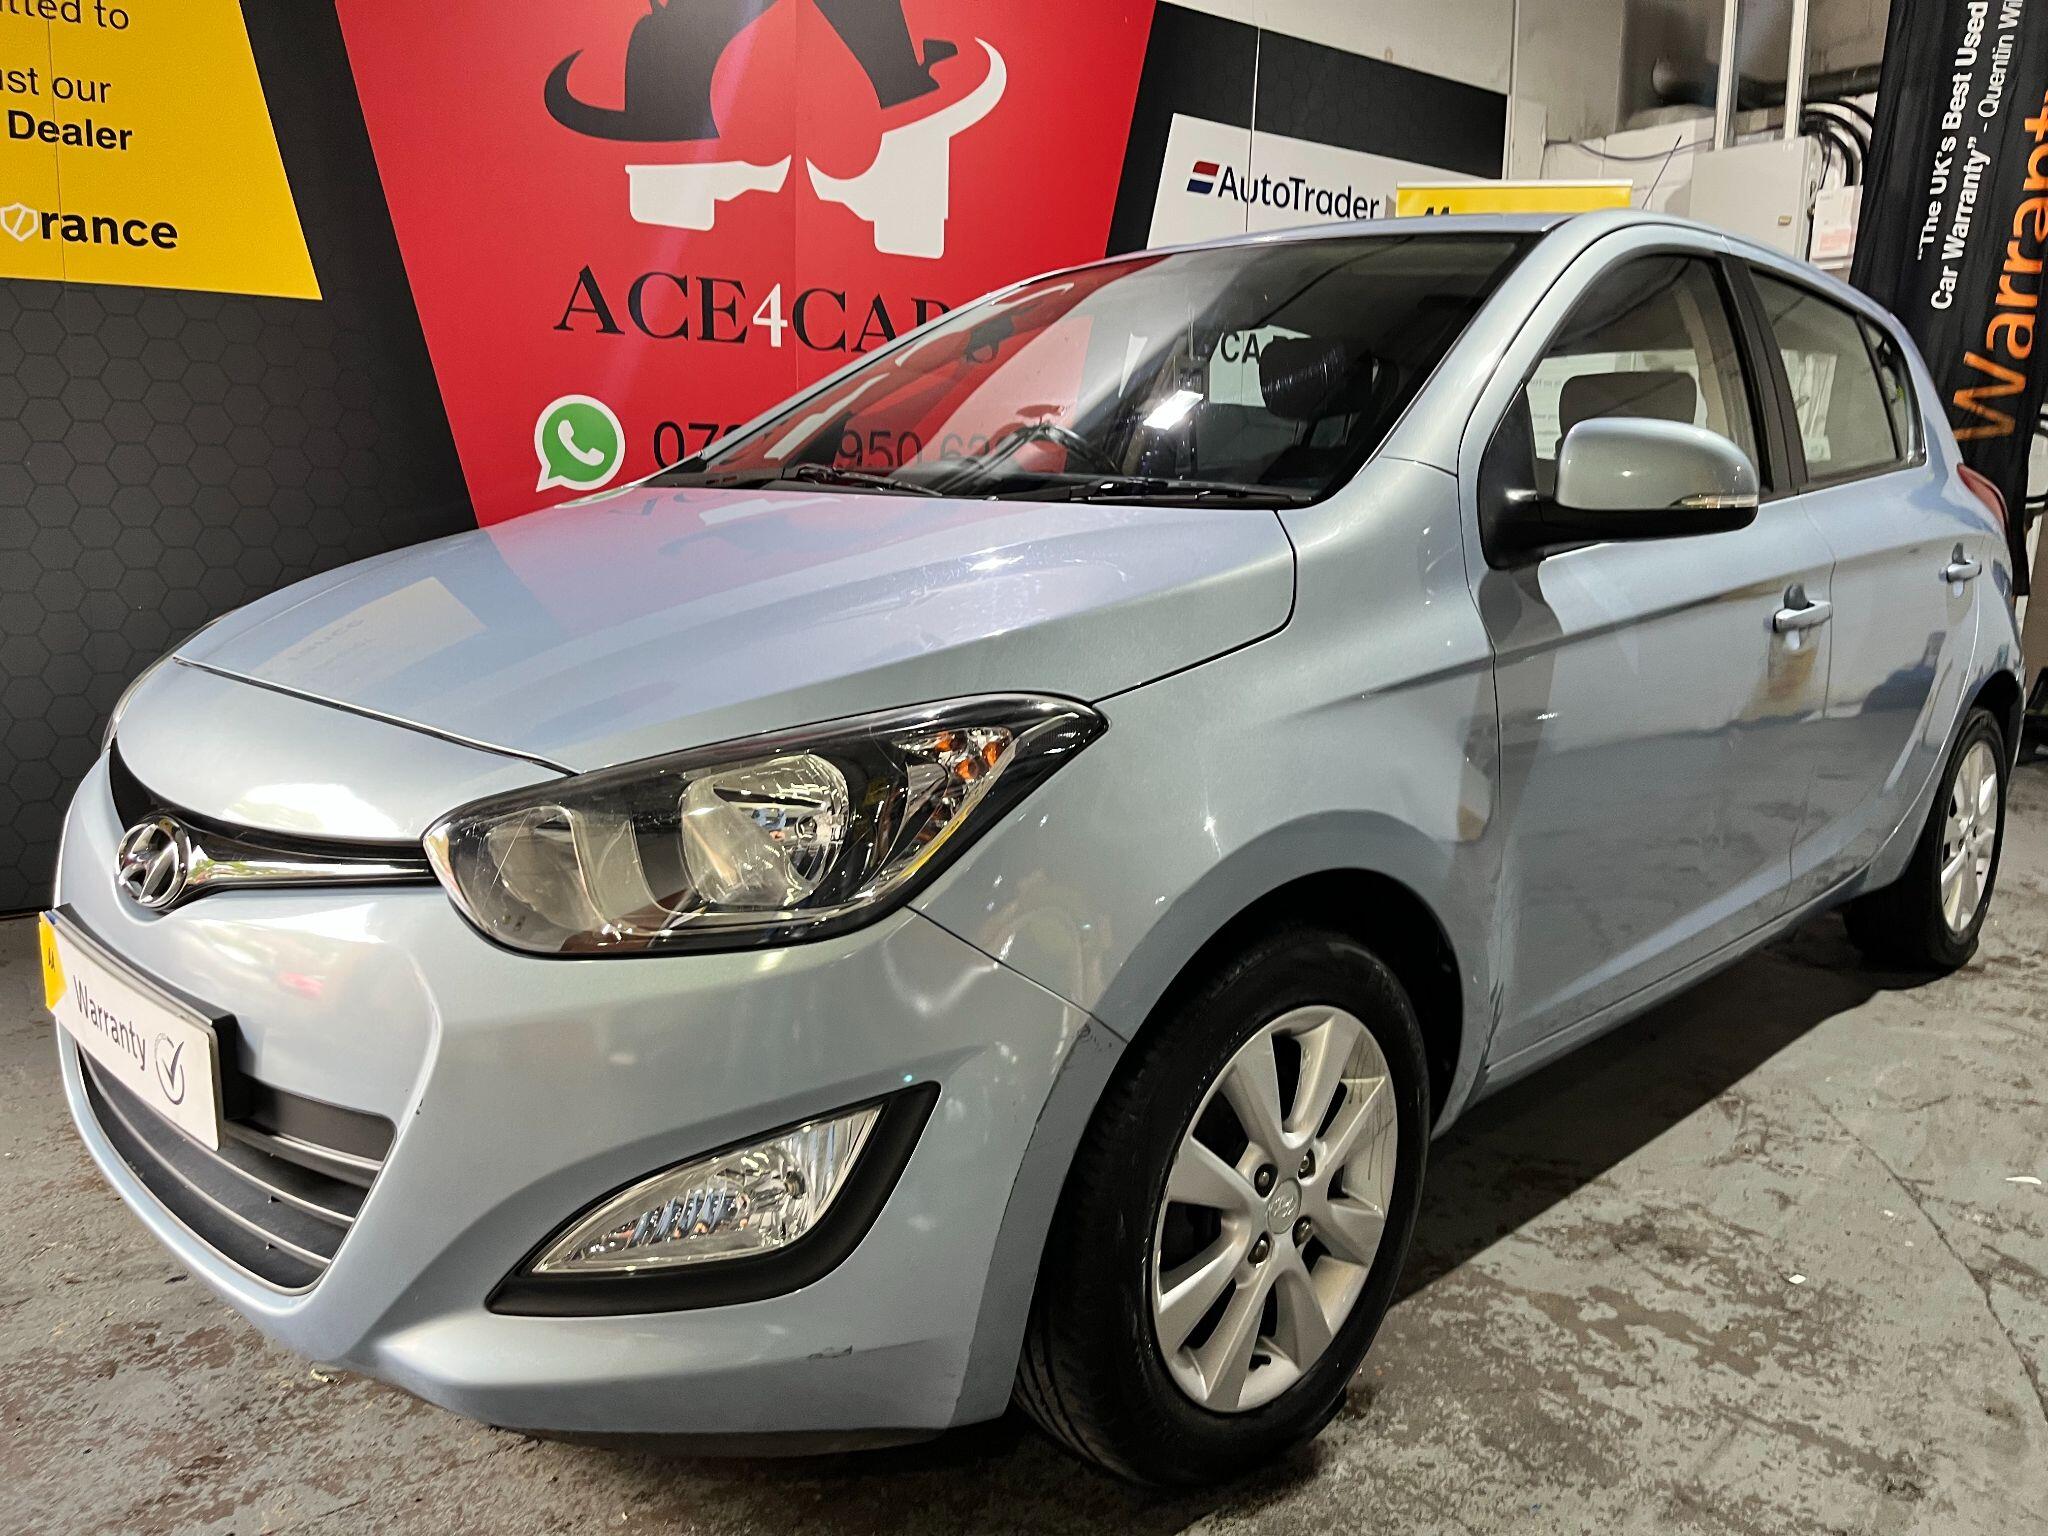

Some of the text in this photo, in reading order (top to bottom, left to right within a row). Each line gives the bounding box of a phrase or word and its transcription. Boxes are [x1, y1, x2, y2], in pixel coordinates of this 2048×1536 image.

[94, 0, 129, 30] to
[1954, 1, 1988, 66] Used
[0, 67, 112, 103] st our
[1941, 72, 1972, 130] Best
[7, 109, 133, 151] Dealer
[1217, 166, 1380, 219] AutoTrader
[1929, 136, 1957, 195] UK’s
[1930, 265, 1958, 310] Car
[1977, 34, 2015, 118] Quentin
[1952, 91, 2048, 442] Warrant
[653, 420, 743, 469] 07
[73, 974, 146, 1071] Warranty
